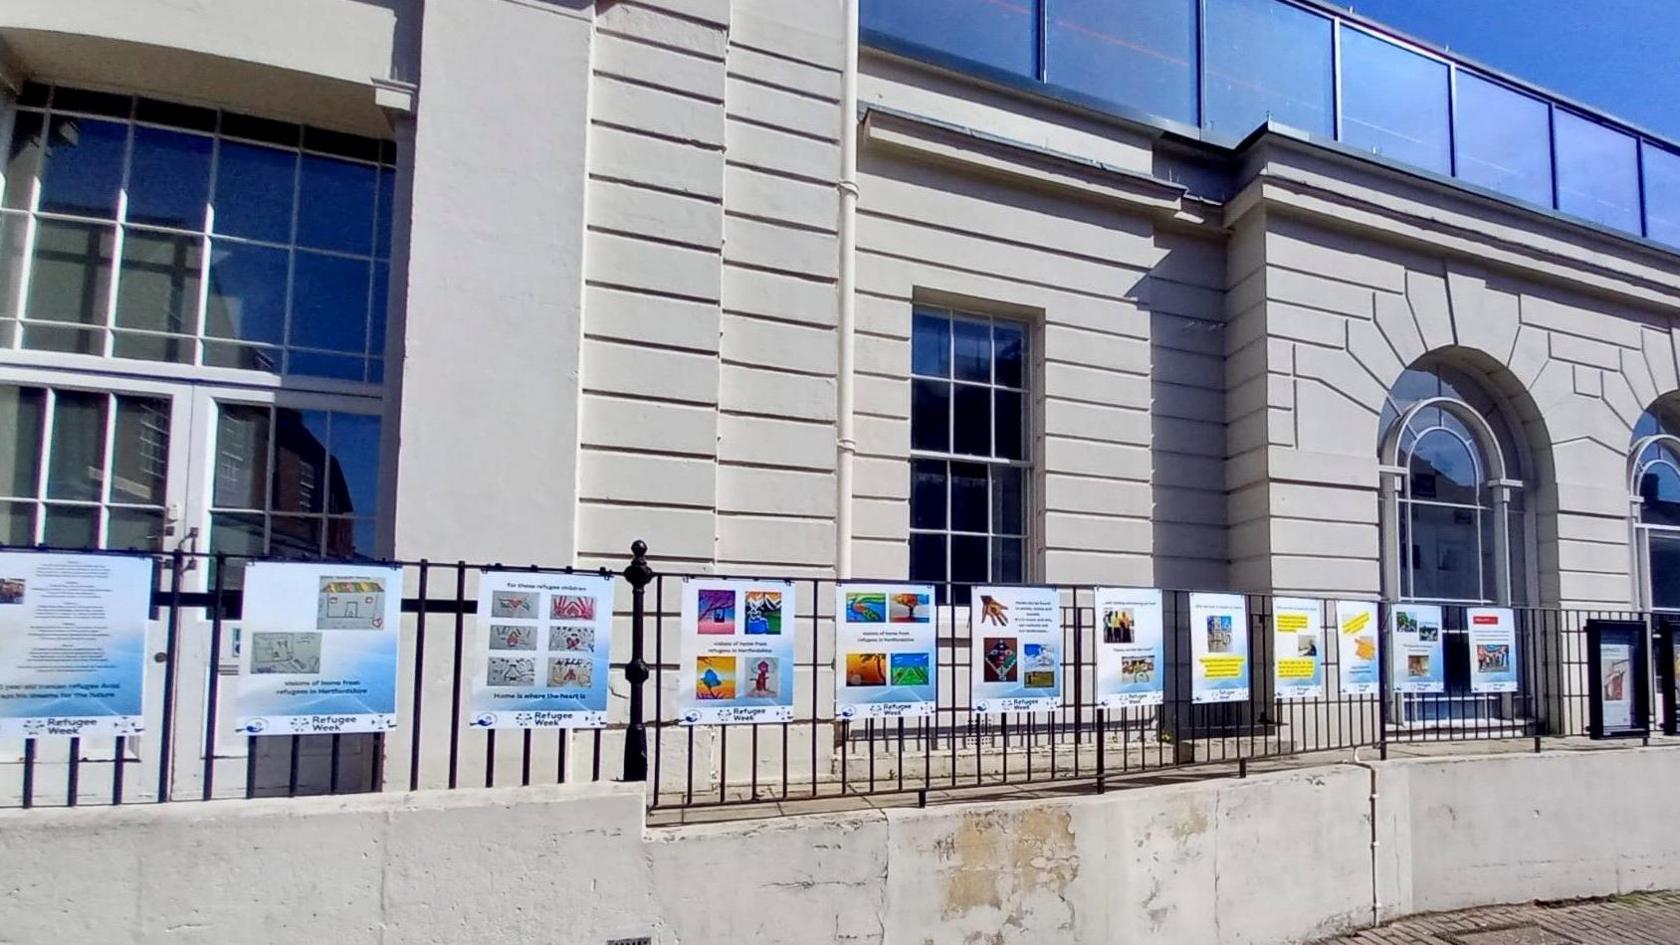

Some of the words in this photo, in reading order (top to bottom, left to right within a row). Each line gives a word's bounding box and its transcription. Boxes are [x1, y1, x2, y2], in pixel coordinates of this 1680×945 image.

[883, 703, 911, 711] Refugee
[534, 711, 573, 720] Refugee
[733, 708, 766, 716] Refugee
[47, 718, 98, 728] Refugee
[312, 715, 357, 725] Refugee
[48, 727, 80, 735] Week
